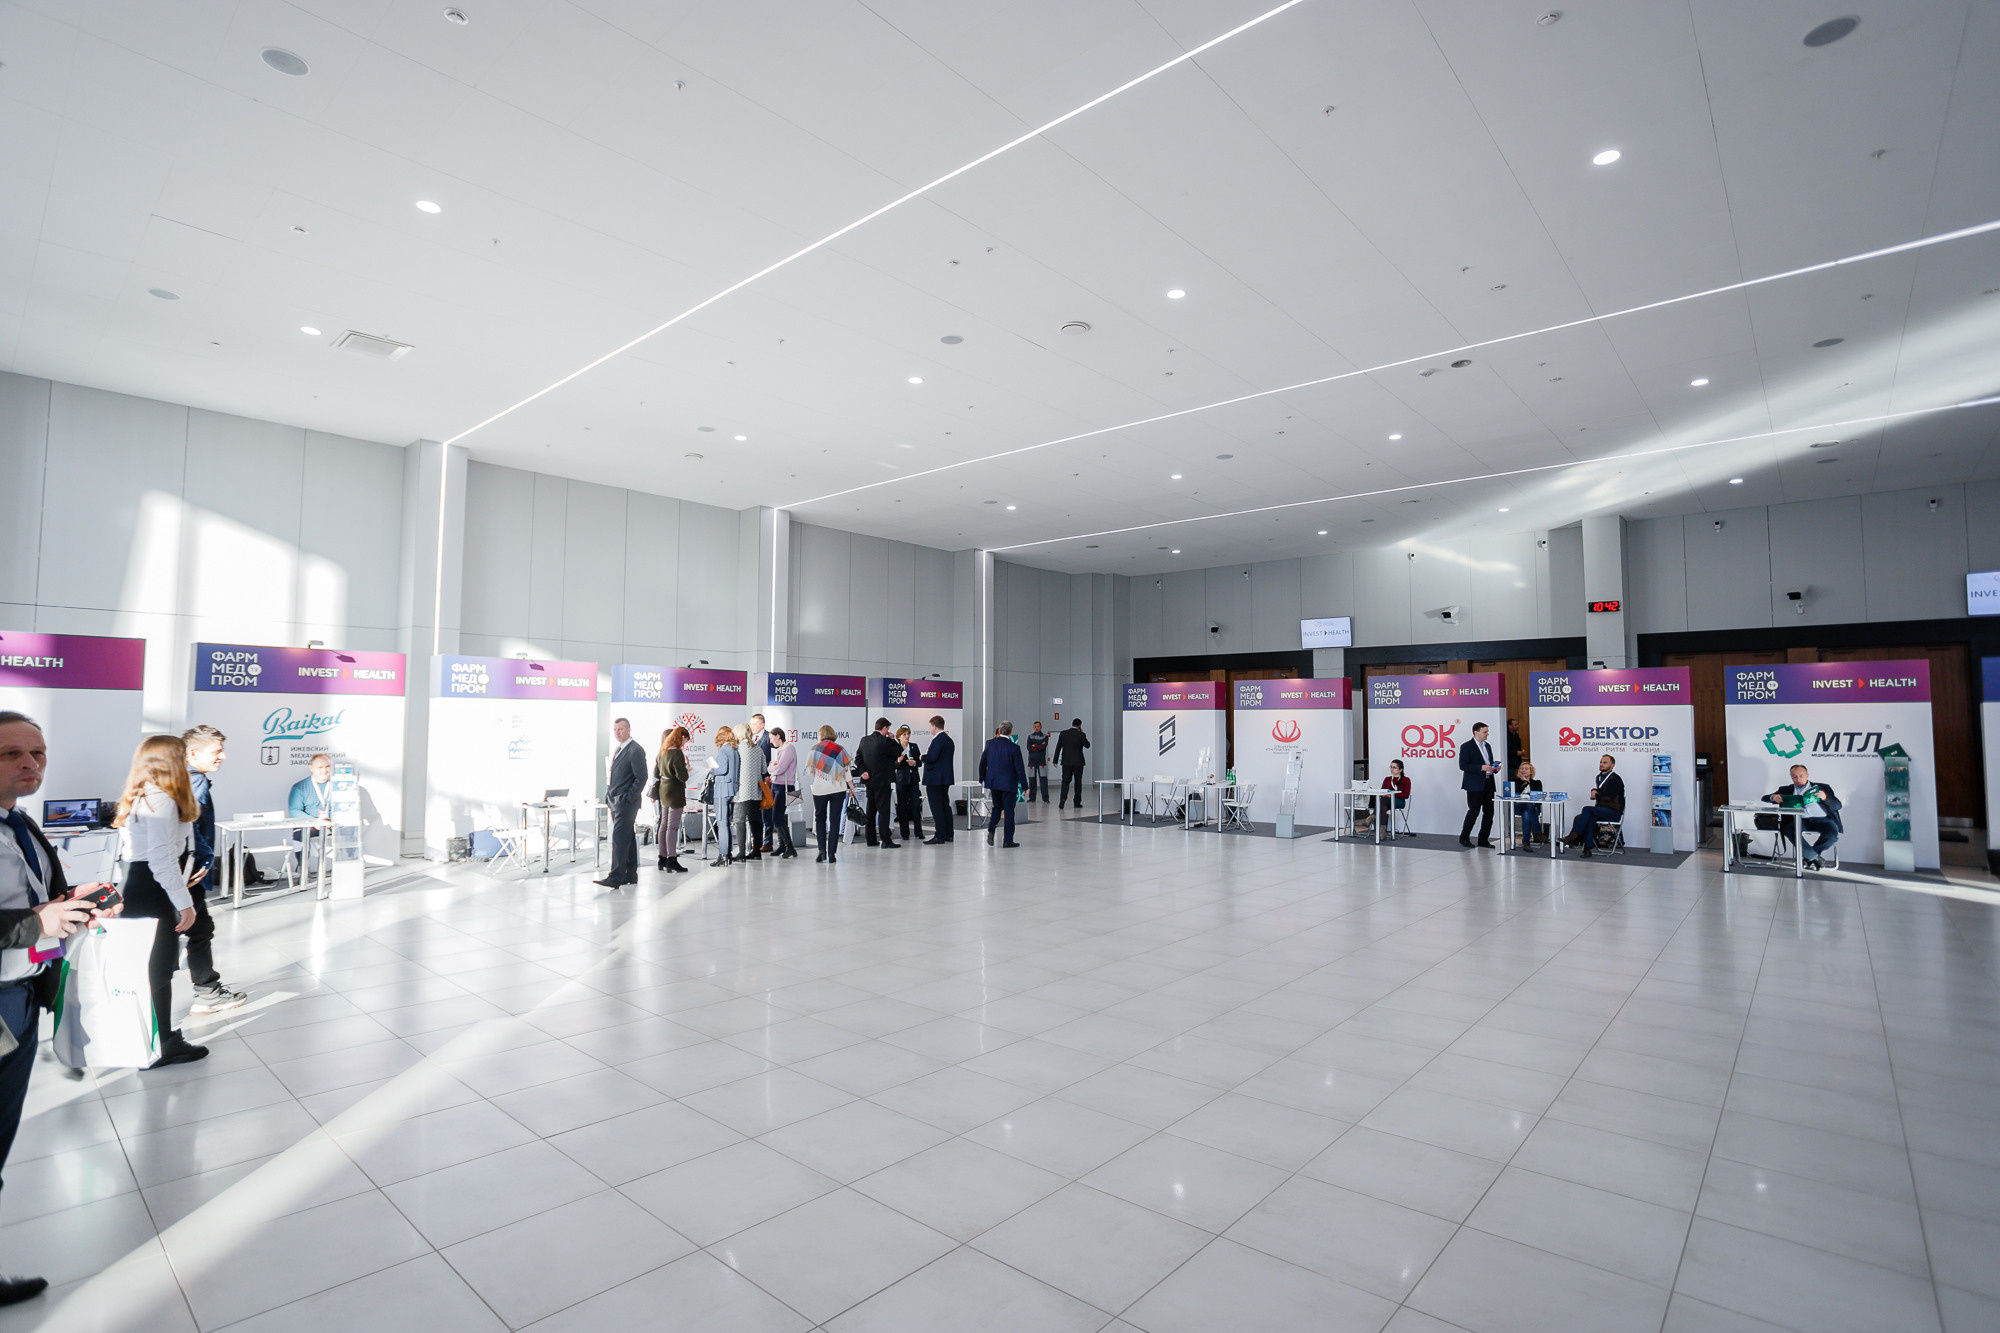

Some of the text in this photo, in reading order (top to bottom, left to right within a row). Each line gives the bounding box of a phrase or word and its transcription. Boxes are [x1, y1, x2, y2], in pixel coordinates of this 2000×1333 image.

[1970, 589, 2000, 598] INVE
[0, 654, 64, 668] HEALTH
[211, 650, 258, 663] ФАРМ
[211, 663, 246, 675] МЕД
[451, 662, 487, 674] ФАРМ
[298, 666, 396, 681] INVEST HEALTH
[451, 673, 477, 683] МЕД
[633, 671, 661, 681] ФАРМ
[1736, 671, 1775, 680] ФАРМ
[210, 675, 258, 687] ПРОМ
[515, 676, 590, 687] INVEST HEALTH
[633, 681, 655, 690] МЕД
[1373, 681, 1399, 689] ФАРМ
[1537, 677, 1569, 685] ФАРМ
[1737, 681, 1765, 691] МЕД
[1812, 678, 1917, 689] INVEST HEALTH
[451, 683, 487, 694] ПРОМ
[683, 683, 742, 693] INVEST HEALTH
[775, 686, 791, 695] МЕД
[1374, 689, 1393, 697] МЕД
[1423, 687, 1490, 696] INVEST HEALTH
[1538, 685, 1561, 694] МЕД
[1598, 683, 1680, 693] INVEST HEALTH
[633, 689, 661, 699] ПРОМ
[774, 694, 797, 702] ПРОМ
[1240, 692, 1256, 700] МЕД
[1280, 691, 1303, 699] INVEST
[1538, 694, 1570, 703] ПРОМ
[1737, 690, 1776, 700] ПРОМ
[888, 697, 907, 705] ПРОМ
[1239, 699, 1262, 707] ПРОМ
[1374, 697, 1400, 705] ПРОМ
[261, 707, 346, 735] Baikal
[1582, 726, 1659, 739] ВЕКТОР
[1812, 732, 1883, 752] МТЛ
